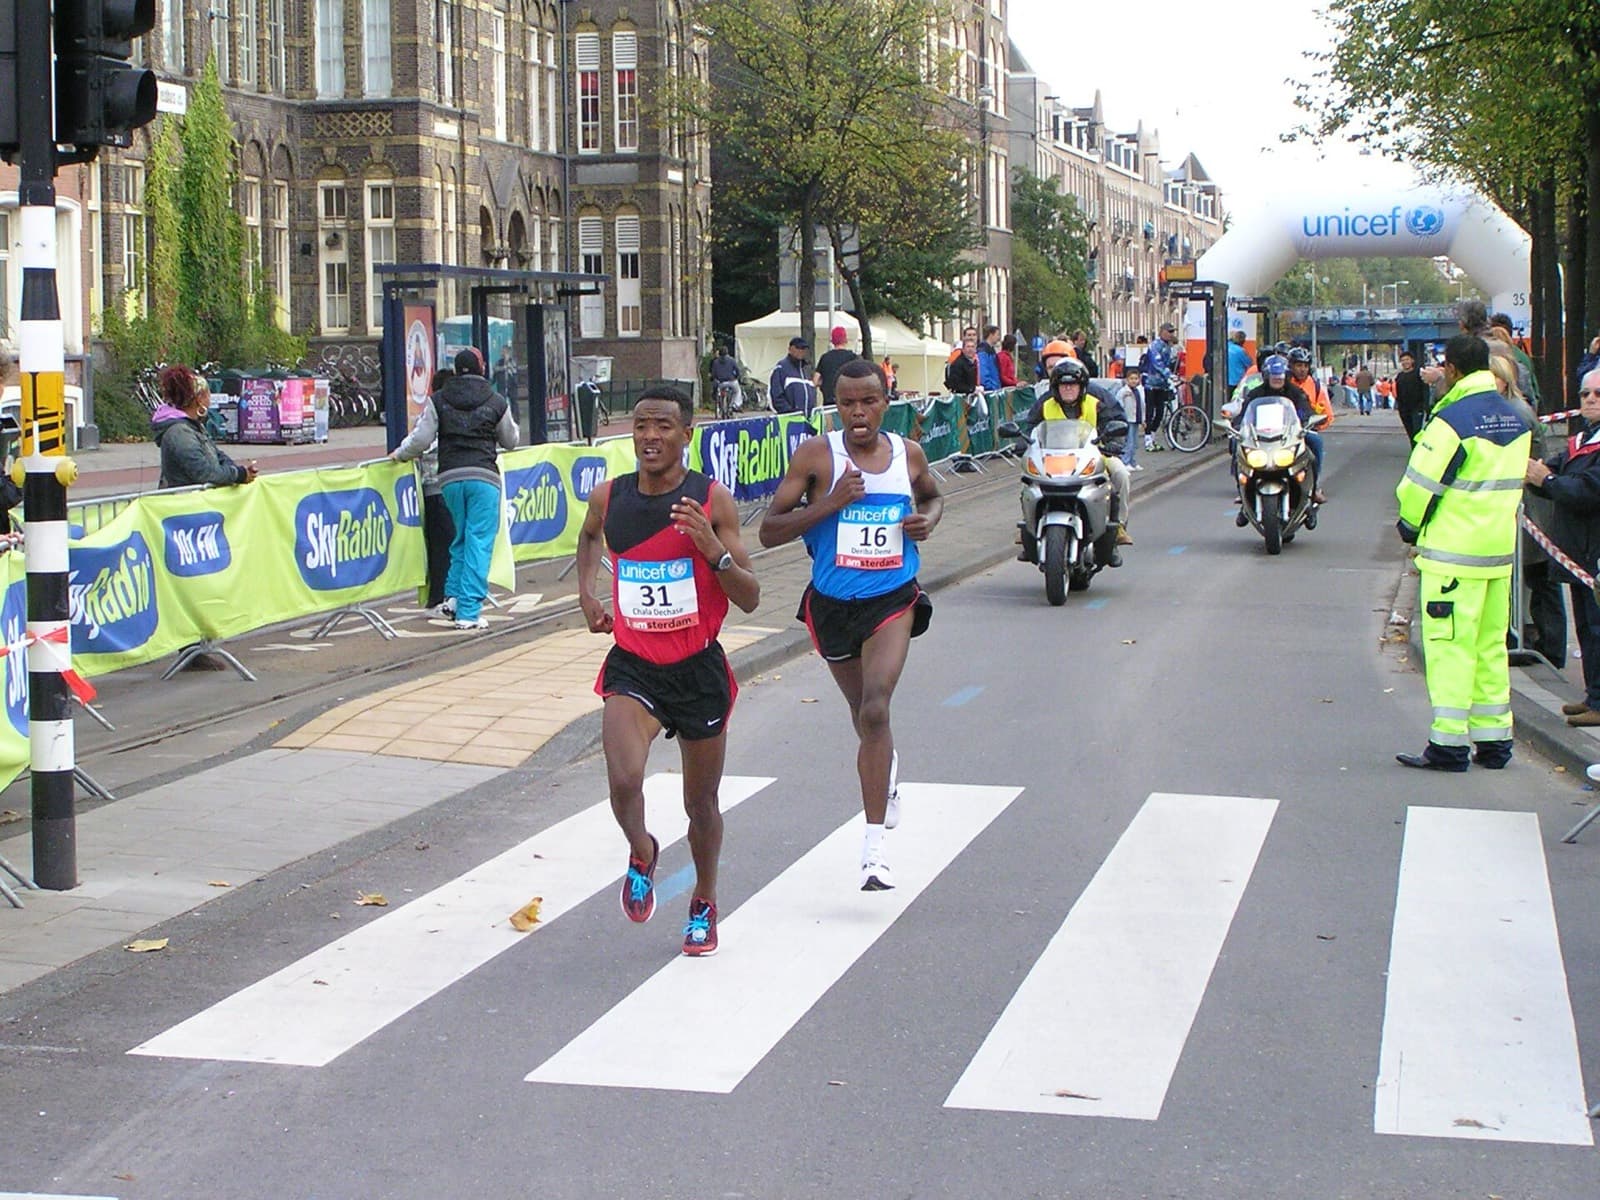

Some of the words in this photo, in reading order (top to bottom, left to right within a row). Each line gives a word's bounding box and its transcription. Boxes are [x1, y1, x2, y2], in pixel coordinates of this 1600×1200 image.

[1303, 206, 1401, 237] unicef
[1512, 292, 1526, 306] 35
[710, 421, 781, 496] SkyRadio
[842, 507, 889, 521] unicef
[173, 528, 198, 566] 101
[197, 523, 220, 561] FM
[306, 501, 388, 577] SkyRadio
[859, 526, 887, 547] 16
[621, 562, 668, 580] unicef
[640, 585, 673, 607] 31
[632, 607, 652, 616] Chala
